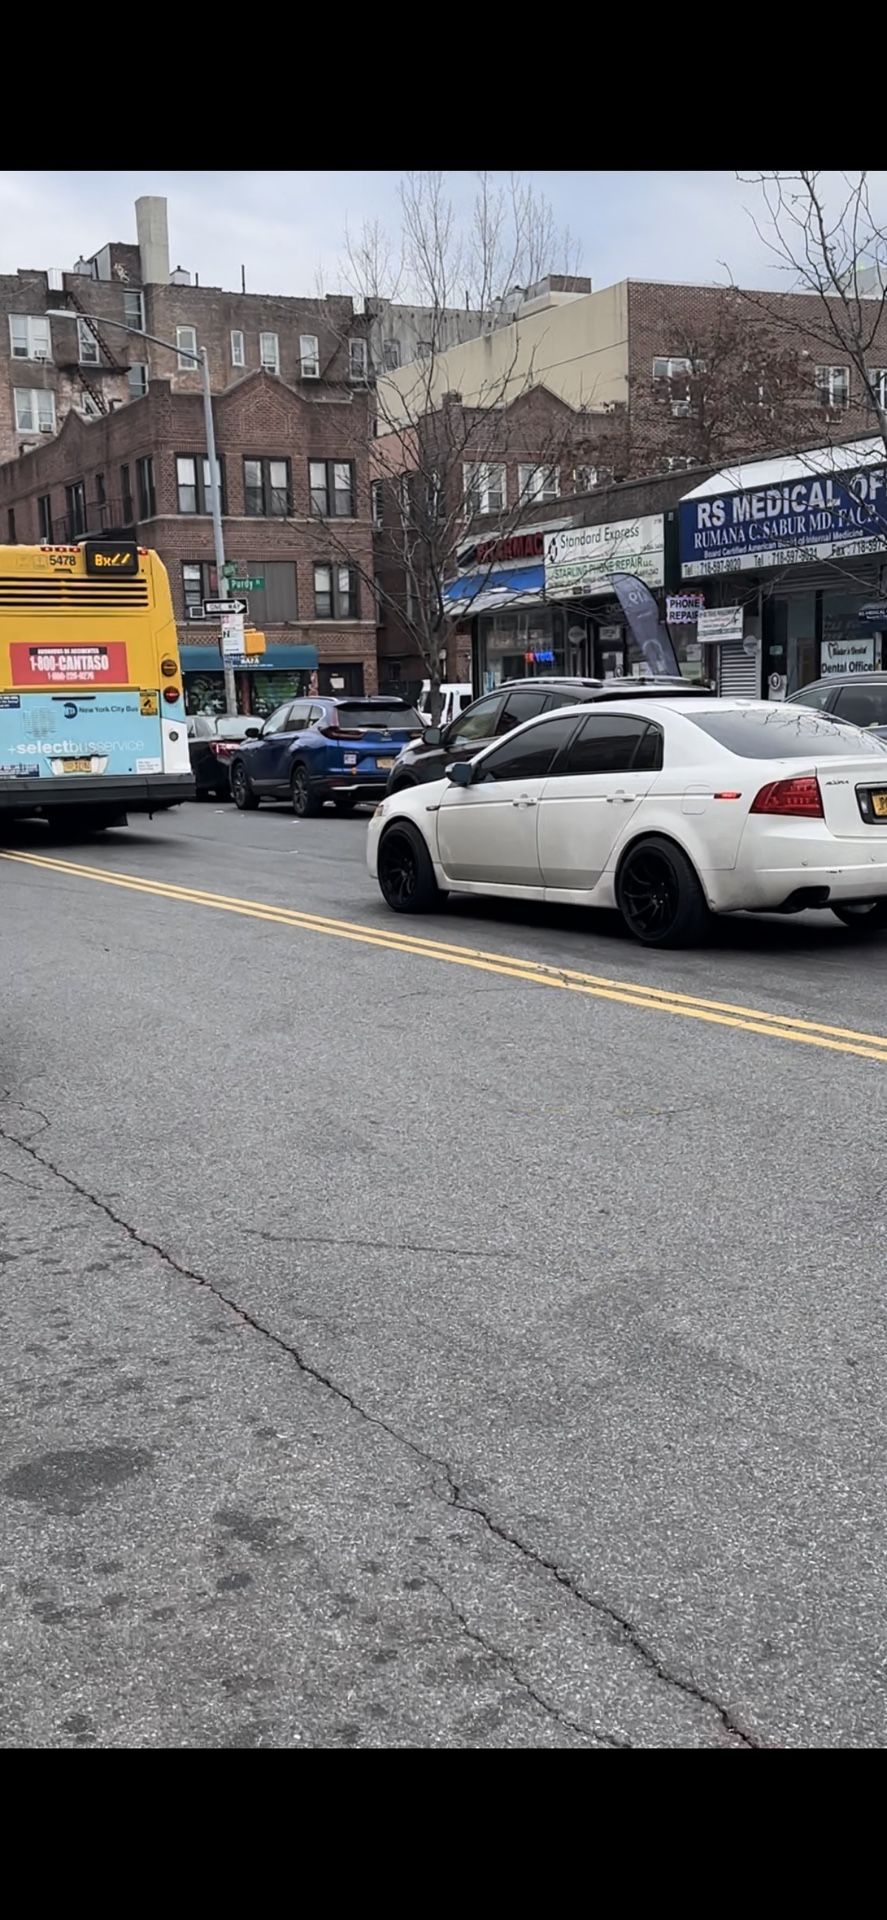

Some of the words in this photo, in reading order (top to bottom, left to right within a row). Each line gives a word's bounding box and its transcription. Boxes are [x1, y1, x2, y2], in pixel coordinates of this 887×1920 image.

[697, 500, 726, 529] RS
[732, 480, 841, 523] MEDICAL
[850, 469, 887, 501] OF
[560, 533, 601, 549] Standard
[604, 526, 640, 541] Express
[694, 526, 746, 549] RUMANA
[748, 524, 760, 540] C.
[762, 516, 806, 540] SABUR
[748, 542, 777, 553] American
[833, 530, 863, 540] Medicine
[49, 555, 77, 566] 5478
[554, 565, 588, 579] STARLING
[615, 557, 643, 570] REPAIR
[670, 599, 700, 608] PHONE
[29, 654, 109, 671] 1-800-CANTASO
[821, 662, 847, 673] Dental
[848, 661, 873, 672] Office
[111, 705, 125, 714] City
